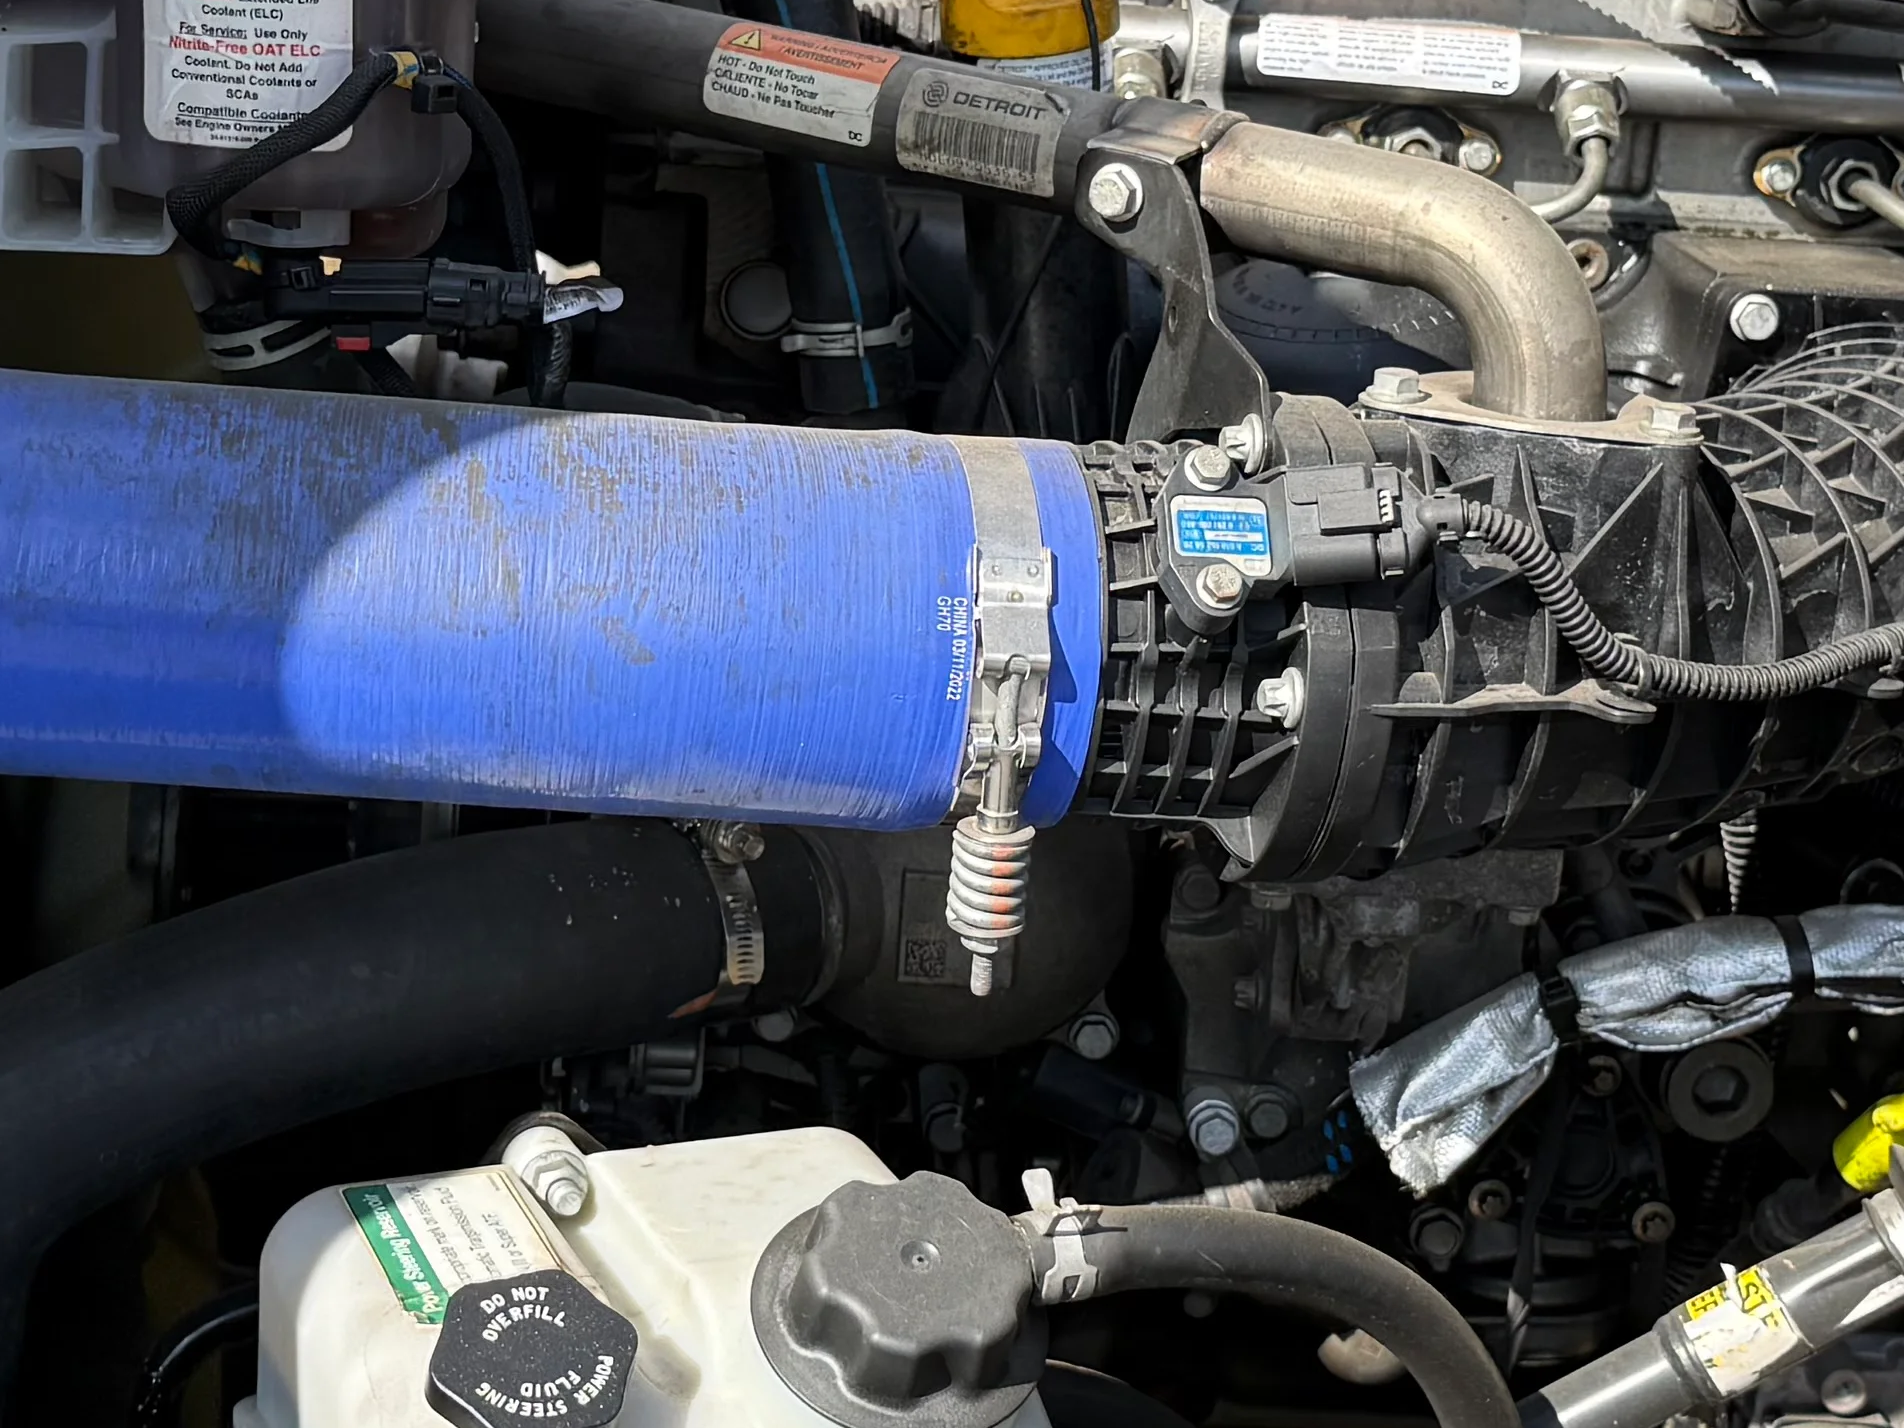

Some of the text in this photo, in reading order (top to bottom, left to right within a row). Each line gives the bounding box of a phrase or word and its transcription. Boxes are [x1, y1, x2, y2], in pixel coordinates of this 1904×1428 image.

[202, 4, 284, 22] Coolant (ELC)
[179, 22, 308, 41] For Service: Use Only
[169, 35, 320, 57] Nitrite-Free OAT ELC
[785, 47, 865, 70] AVERTISSEMENT
[171, 68, 317, 88] Conventional Coolants or
[235, 60, 251, 71] Do
[255, 61, 276, 72] Not
[279, 62, 303, 73] Add
[718, 55, 815, 85] HOT Do Not Touch
[226, 89, 258, 101] SCAs
[715, 67, 819, 100] CALIENTE No Tocar
[1492, 80, 1508, 90] DC
[178, 102, 247, 118] Compatible
[712, 80, 835, 118] CHAUD Ne Pas Toucher
[953, 90, 1047, 120] DETROIT
[175, 117, 192, 128] See
[195, 119, 231, 132] Engine
[233, 122, 274, 133] Owners
[848, 130, 862, 142] DC
[936, 596, 952, 632] GH70
[946, 597, 969, 701] CHINA 03/11/2022
[363, 1192, 444, 1314] Power Steering Reservoir
[480, 1286, 549, 1314] DO NOT
[482, 1303, 566, 1342] OVERFILL
[474, 1354, 615, 1418] POWER STEERING
[520, 1369, 582, 1398] FLUID
